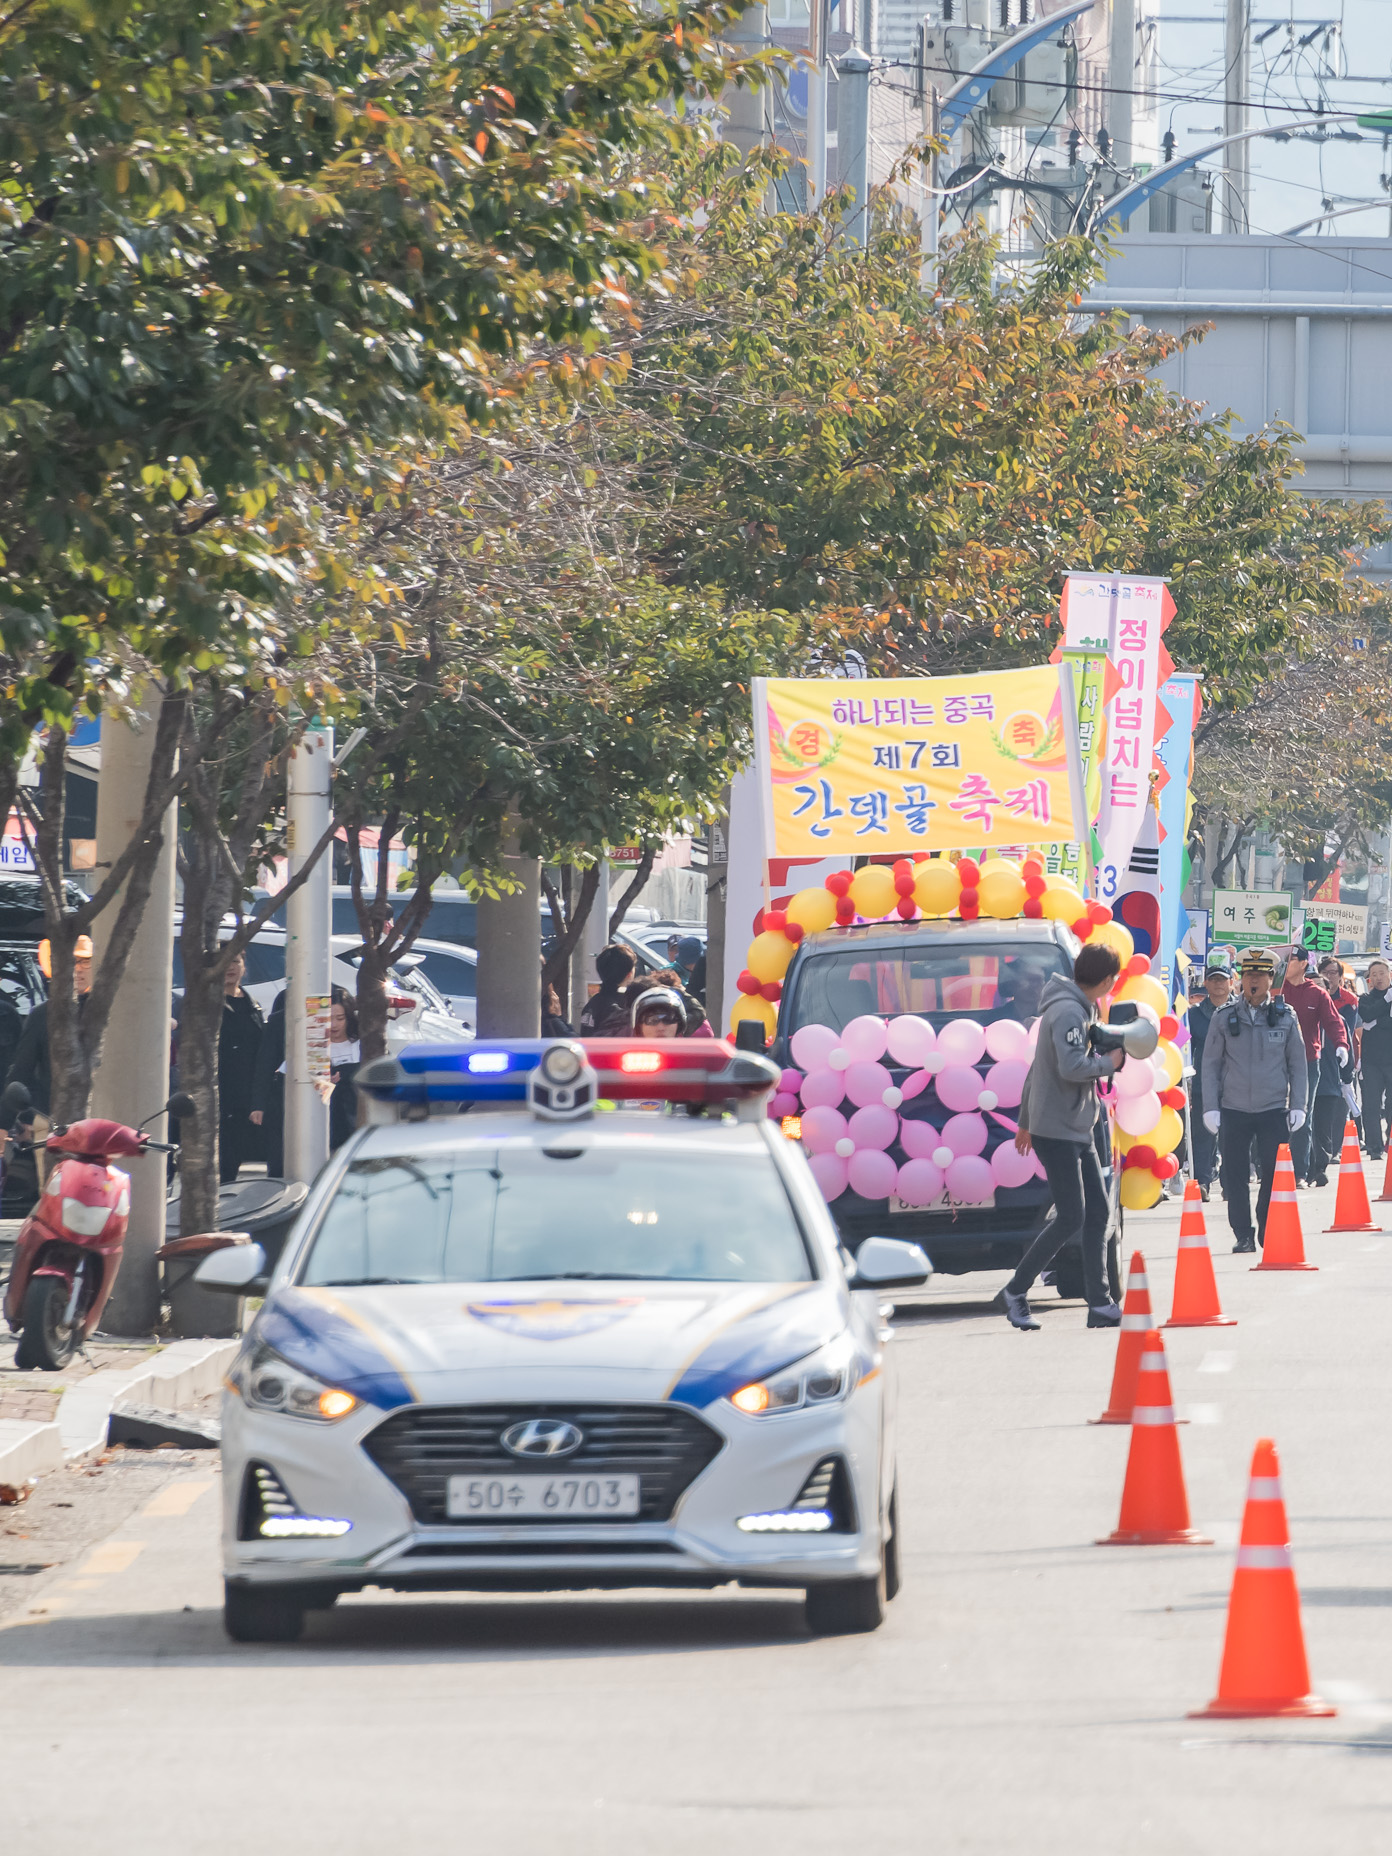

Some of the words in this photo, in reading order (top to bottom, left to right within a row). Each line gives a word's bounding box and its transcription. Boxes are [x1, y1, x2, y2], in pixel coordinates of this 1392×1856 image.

[1134, 586, 1158, 600] 축제
[832, 698, 935, 727] 하나되는
[943, 694, 995, 724] 중곡
[795, 729, 820, 756] 경
[1012, 719, 1037, 747] 축
[873, 741, 961, 769] 제7회
[792, 778, 937, 837] 간뎃골
[949, 774, 1051, 832] 축제
[468, 1481, 525, 1509] 50수
[543, 1480, 621, 1509] 6703
